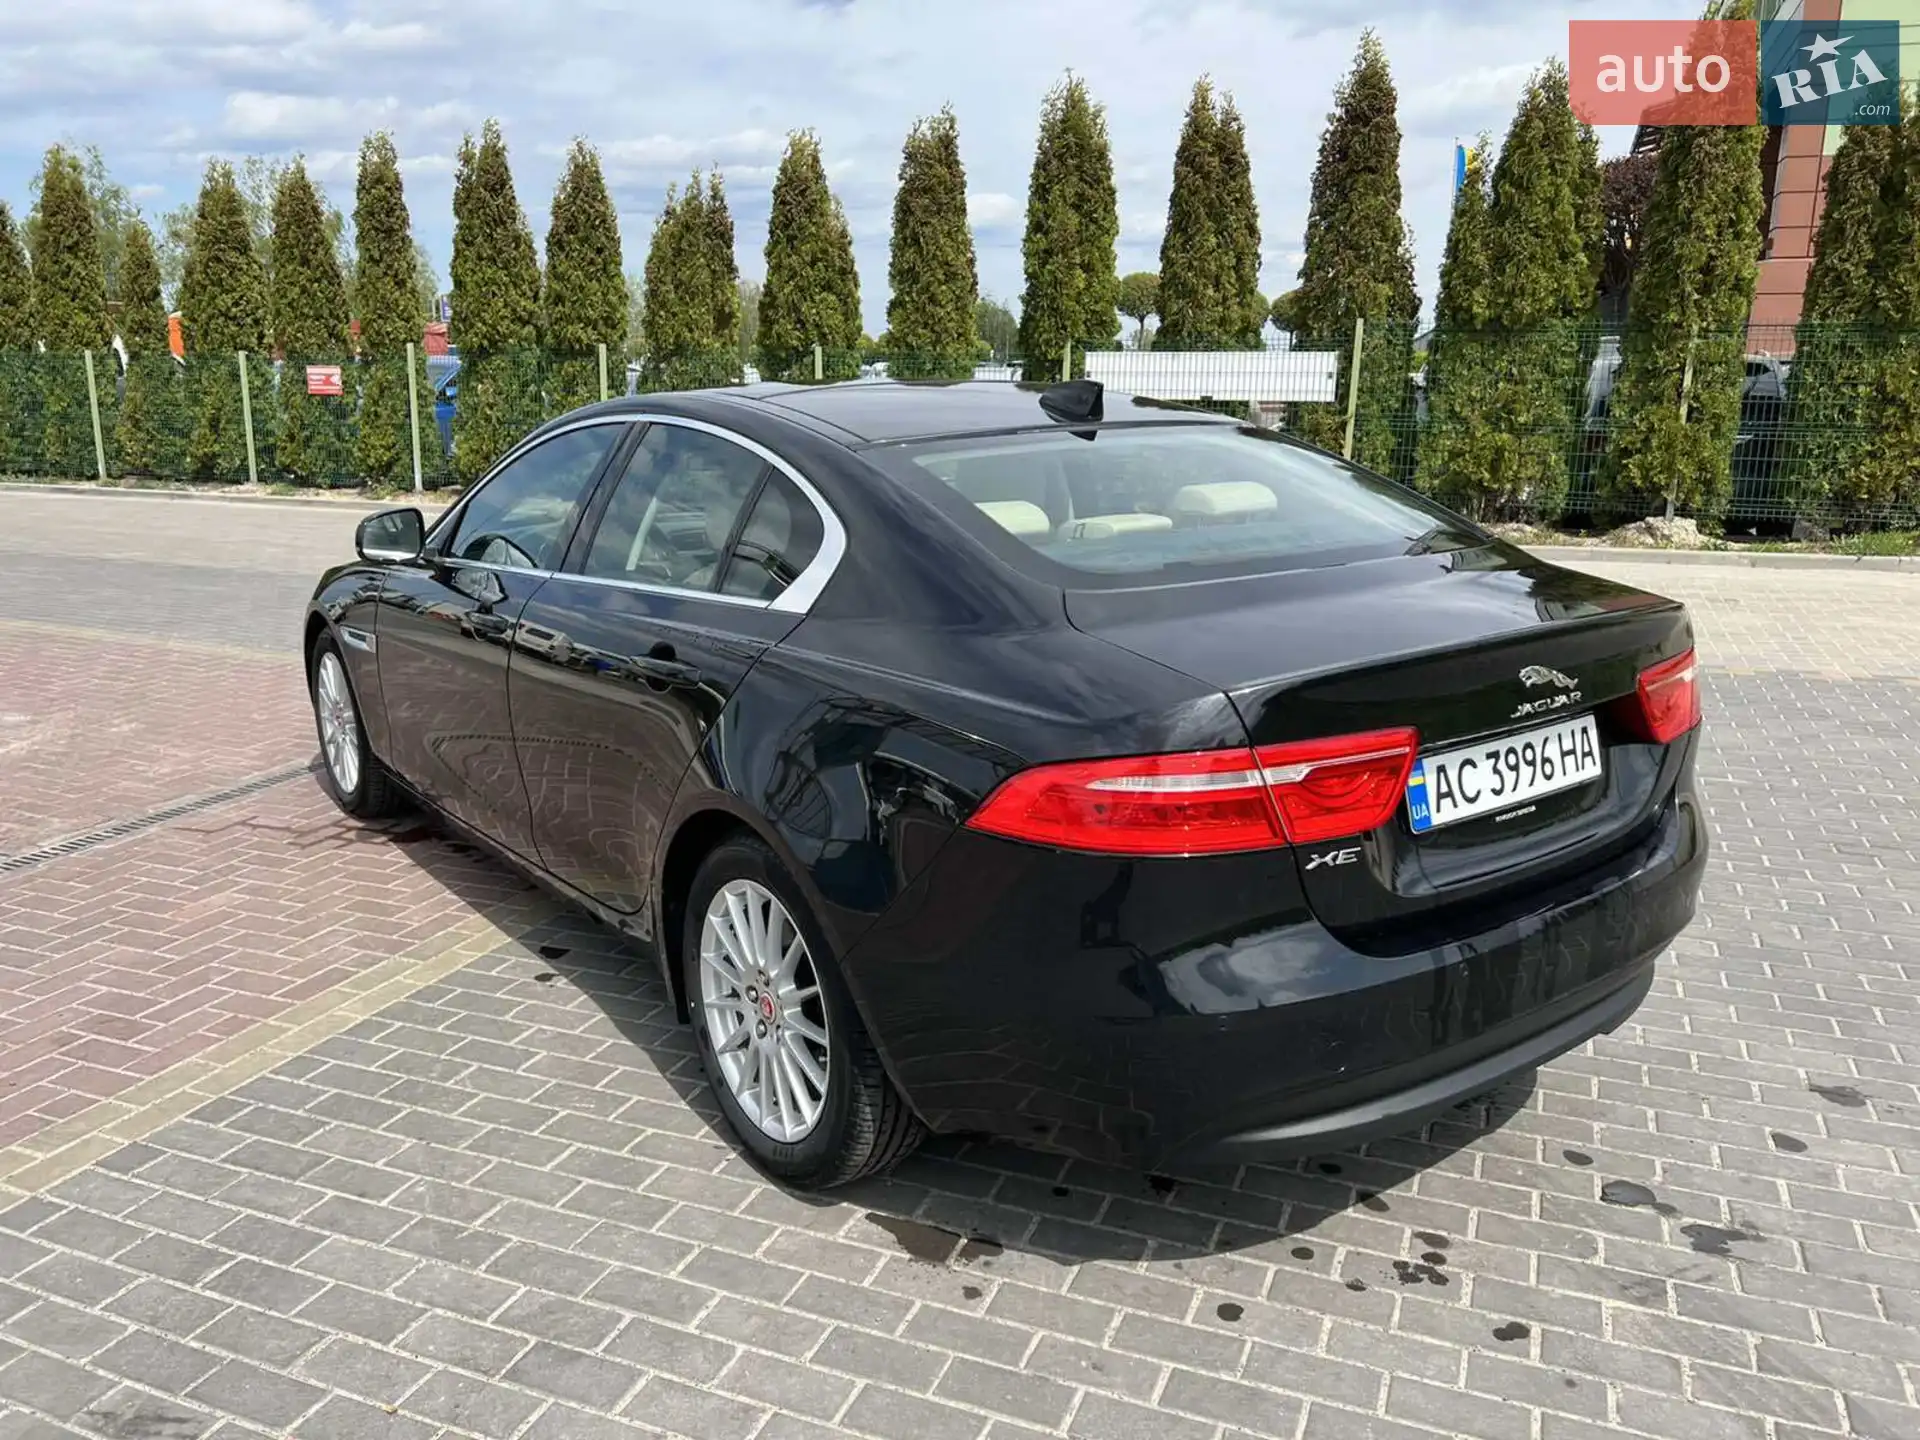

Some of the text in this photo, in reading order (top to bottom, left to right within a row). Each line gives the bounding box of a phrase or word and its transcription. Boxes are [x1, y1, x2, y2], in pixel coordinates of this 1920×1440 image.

[1510, 691, 1582, 718] JAGUAR
[1435, 726, 1596, 813] AC 3996 HA
[1412, 802, 1430, 820] UA
[1305, 846, 1361, 870] XE
